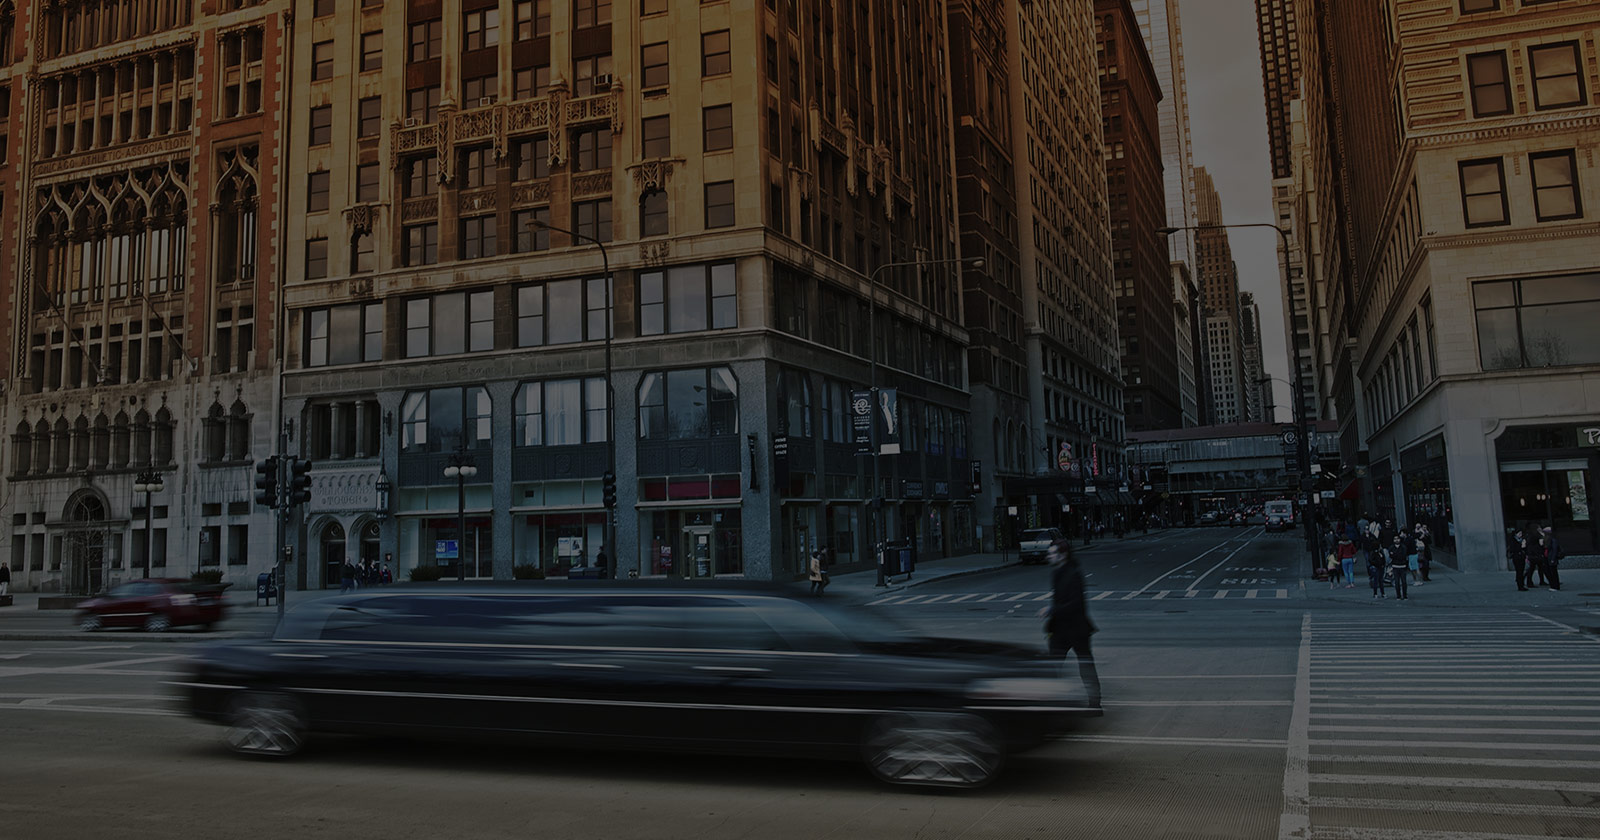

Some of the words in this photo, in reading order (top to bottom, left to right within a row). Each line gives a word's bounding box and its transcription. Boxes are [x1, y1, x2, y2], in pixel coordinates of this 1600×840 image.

[38, 159, 75, 175] CHICAGO
[80, 150, 122, 167] ATHLETIC
[125, 137, 187, 158] ASSOCIATION
[327, 495, 363, 505] TOWER
